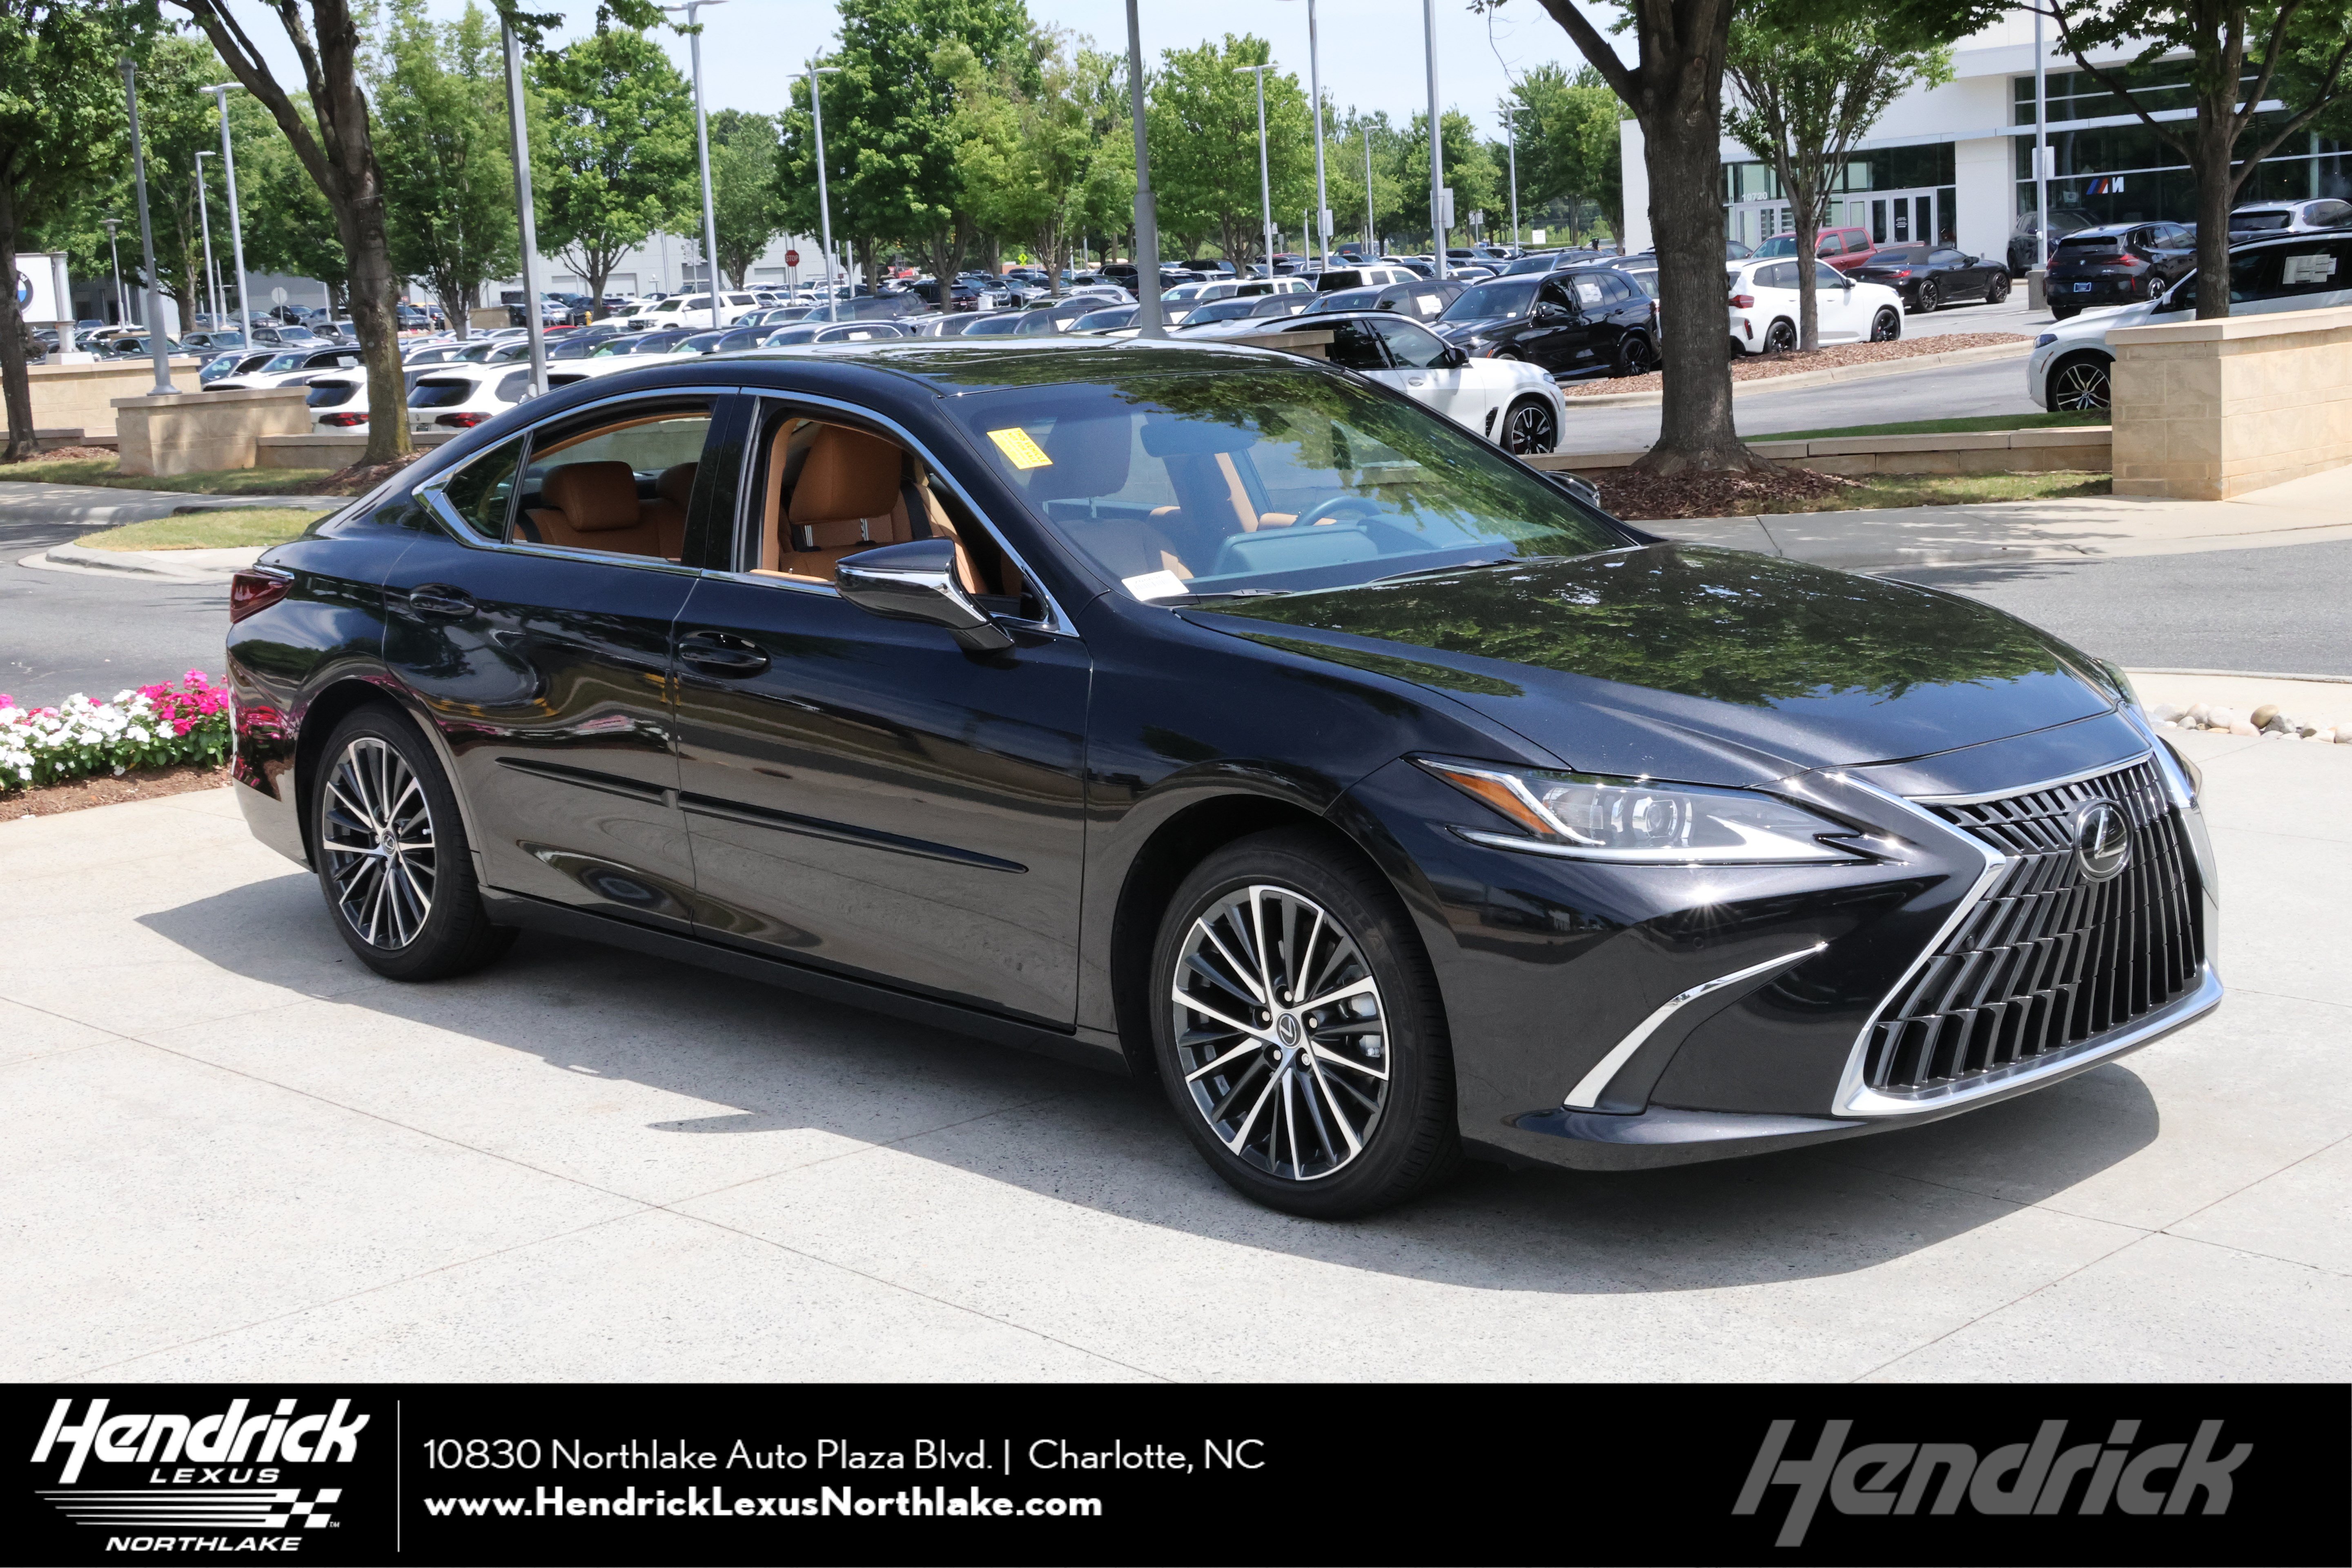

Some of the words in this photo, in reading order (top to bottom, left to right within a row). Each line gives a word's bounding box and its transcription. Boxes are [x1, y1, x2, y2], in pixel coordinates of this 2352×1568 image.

[1742, 192, 1768, 202] 10720
[1013, 430, 1029, 441] THIS
[1023, 441, 1048, 463] VEHICLE
[1024, 452, 1038, 462] SALE
